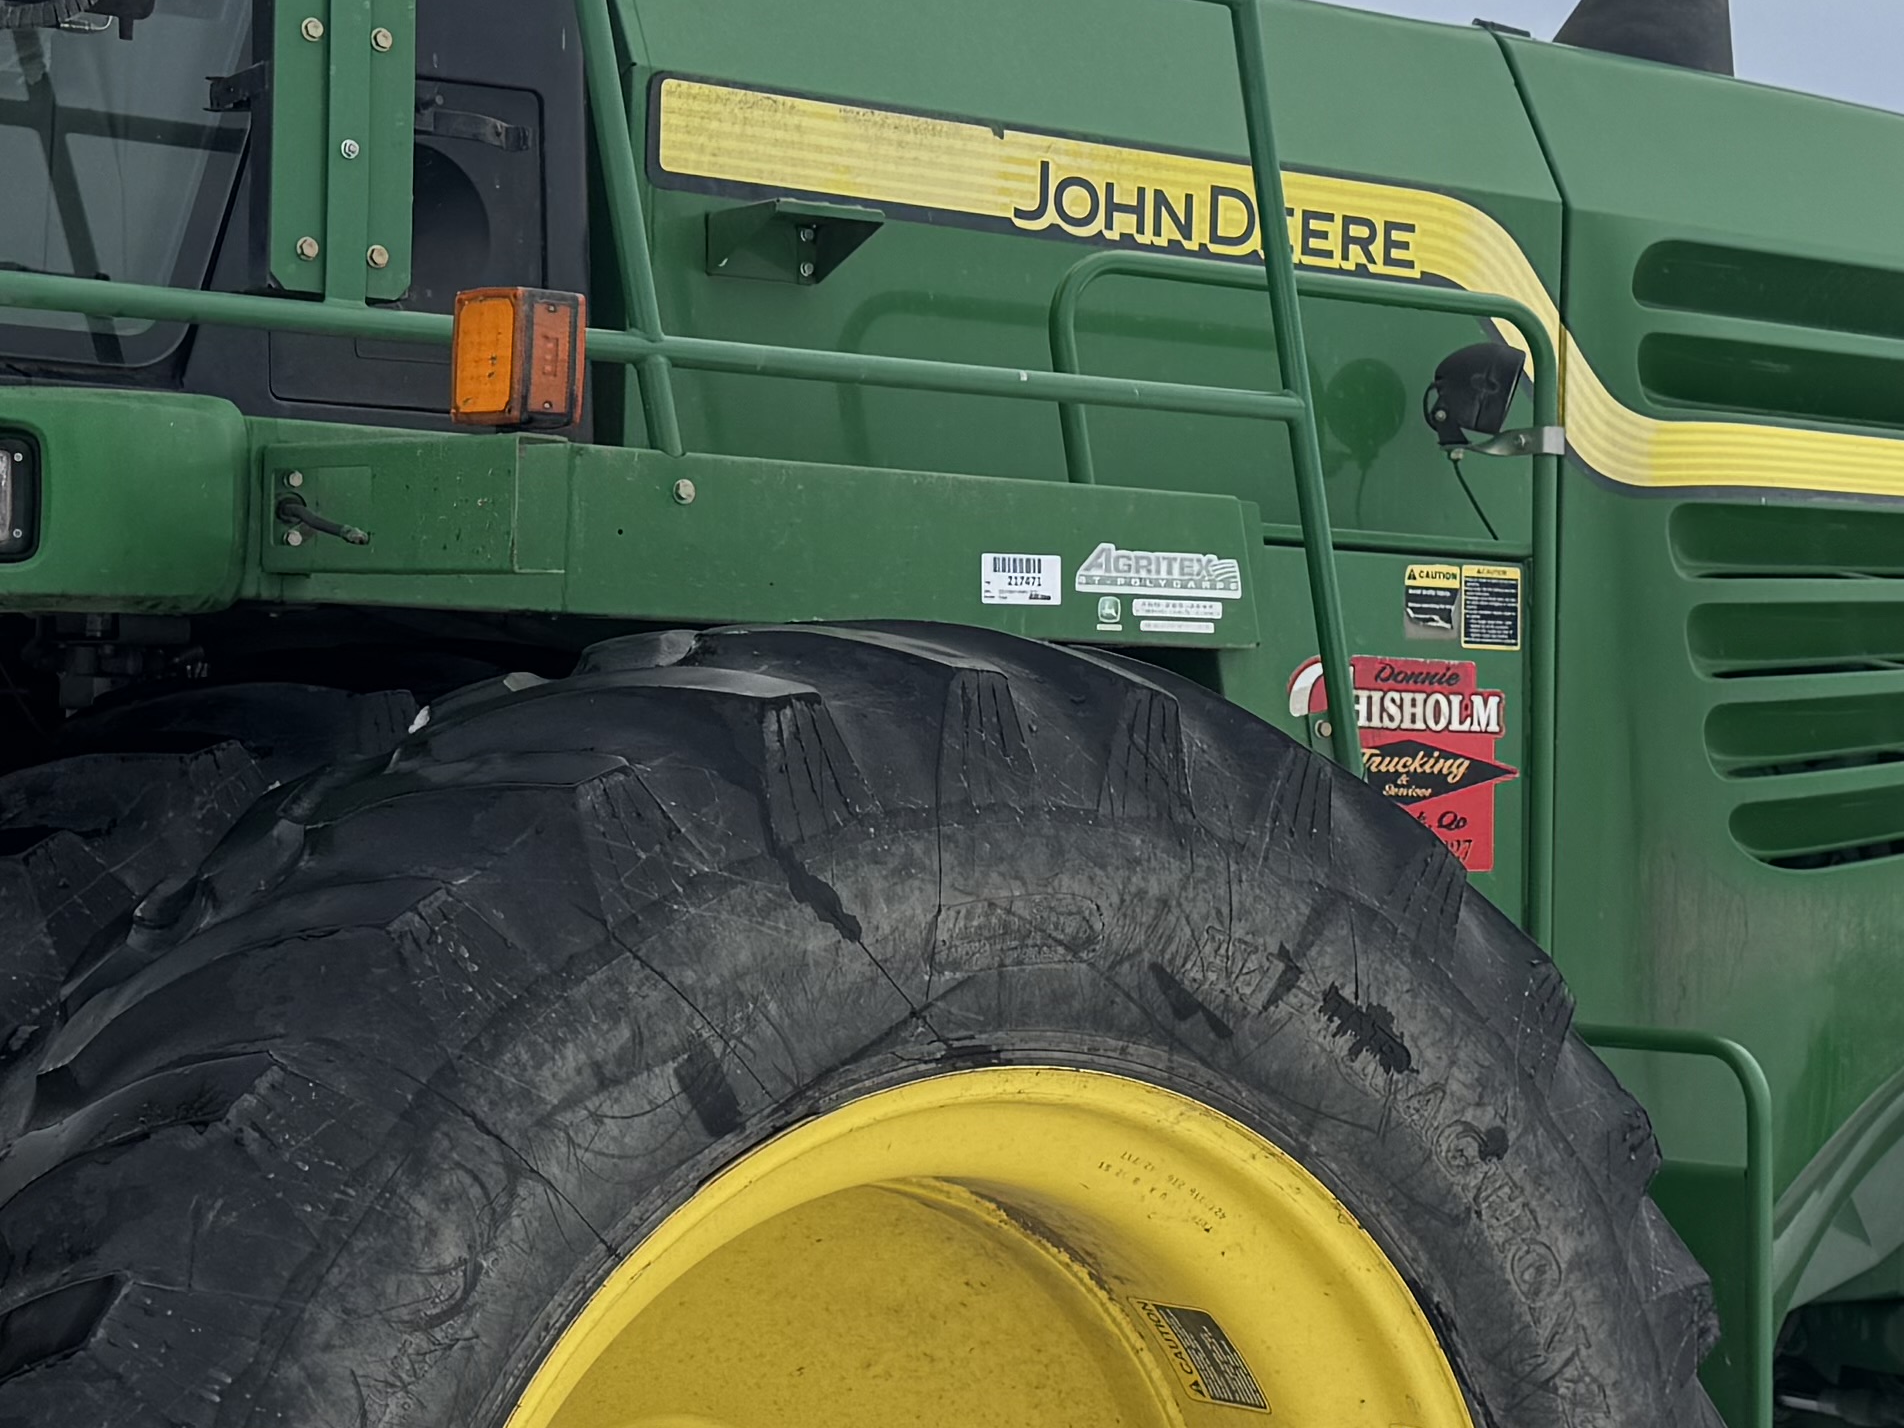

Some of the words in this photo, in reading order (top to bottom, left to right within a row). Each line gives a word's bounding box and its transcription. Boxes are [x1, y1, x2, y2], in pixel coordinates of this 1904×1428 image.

[1013, 160, 1196, 242] JOHN
[1208, 184, 1417, 270] DERE
[1083, 545, 1214, 578] AGRITEX
[1418, 570, 1458, 581] CAUTION
[1007, 575, 1042, 587] 217471
[1375, 663, 1462, 687] Donnie
[1361, 748, 1471, 784] Trucking
[1136, 1300, 1193, 1375] CAUTION
